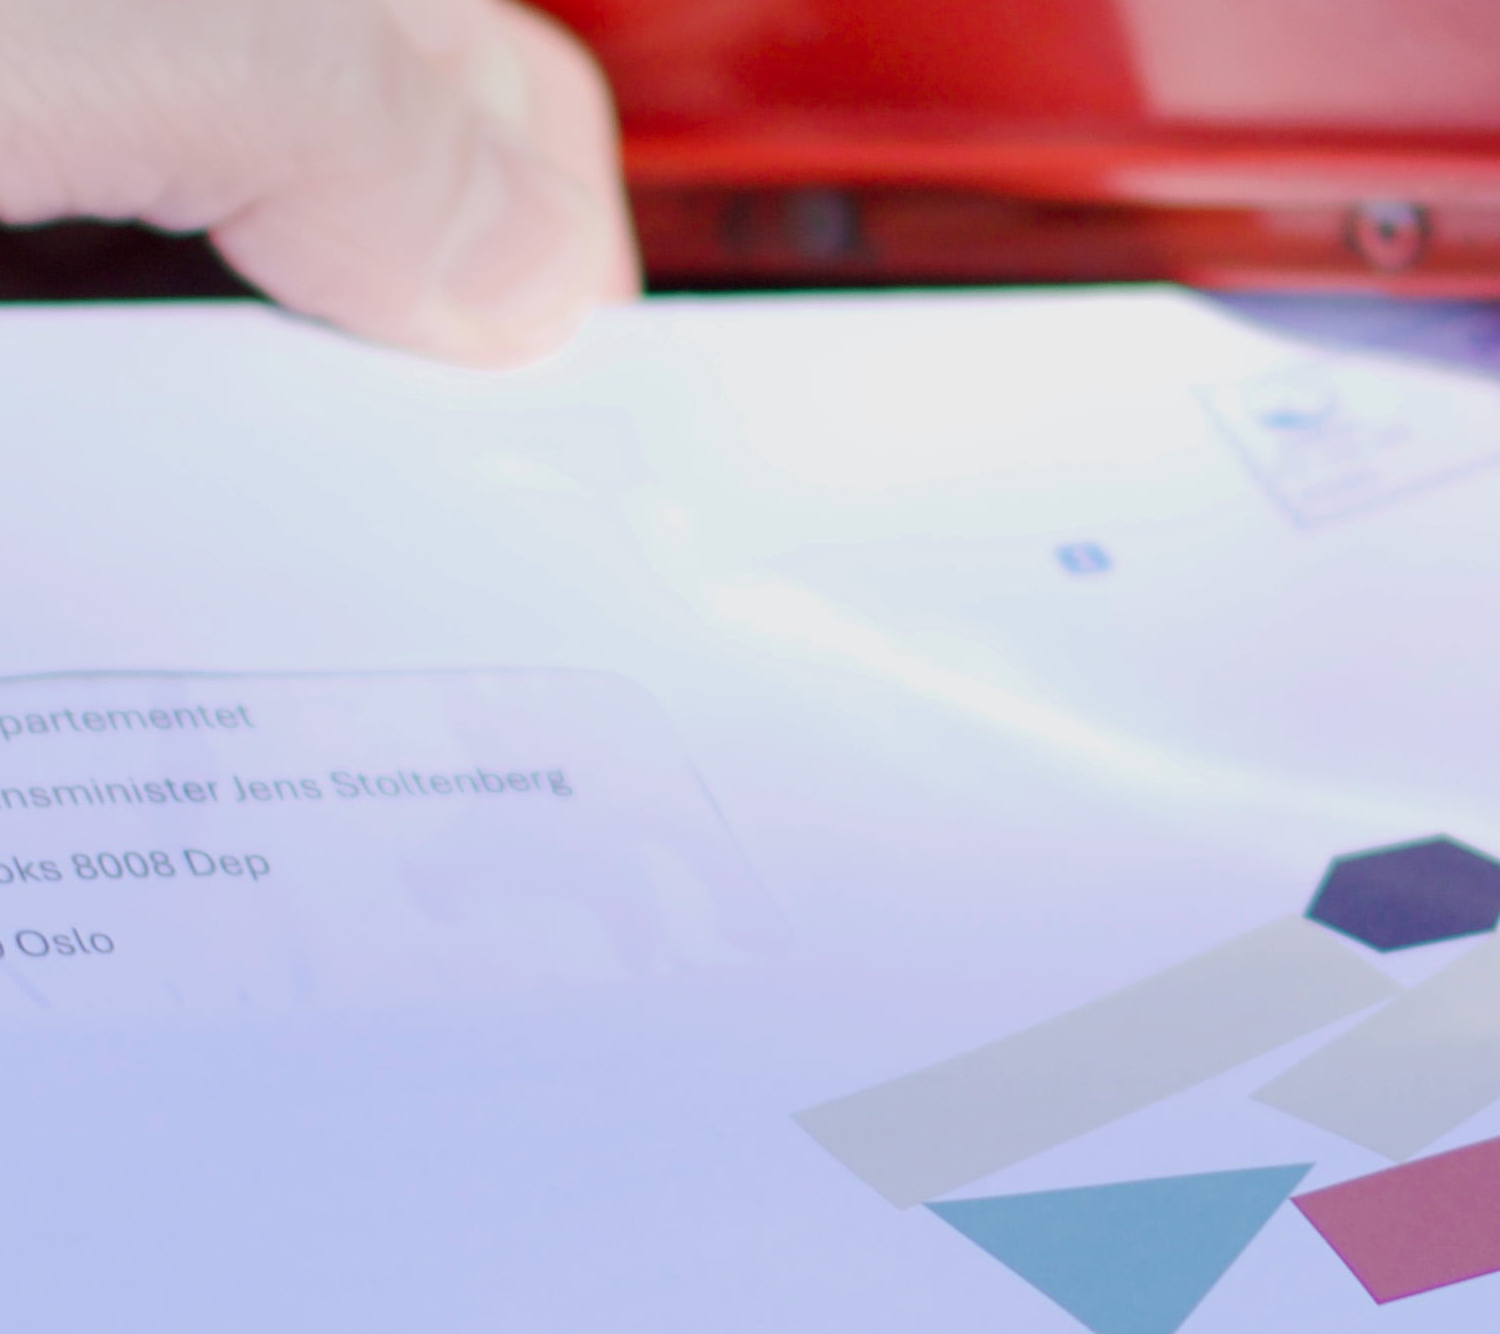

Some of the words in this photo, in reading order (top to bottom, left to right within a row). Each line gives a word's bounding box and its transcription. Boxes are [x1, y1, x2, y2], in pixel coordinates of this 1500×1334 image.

[232, 774, 324, 804] Jens
[330, 767, 573, 799] Stoltenberg
[71, 850, 177, 881] 8008
[183, 848, 271, 881] Dep
[14, 924, 116, 957] Oslo
